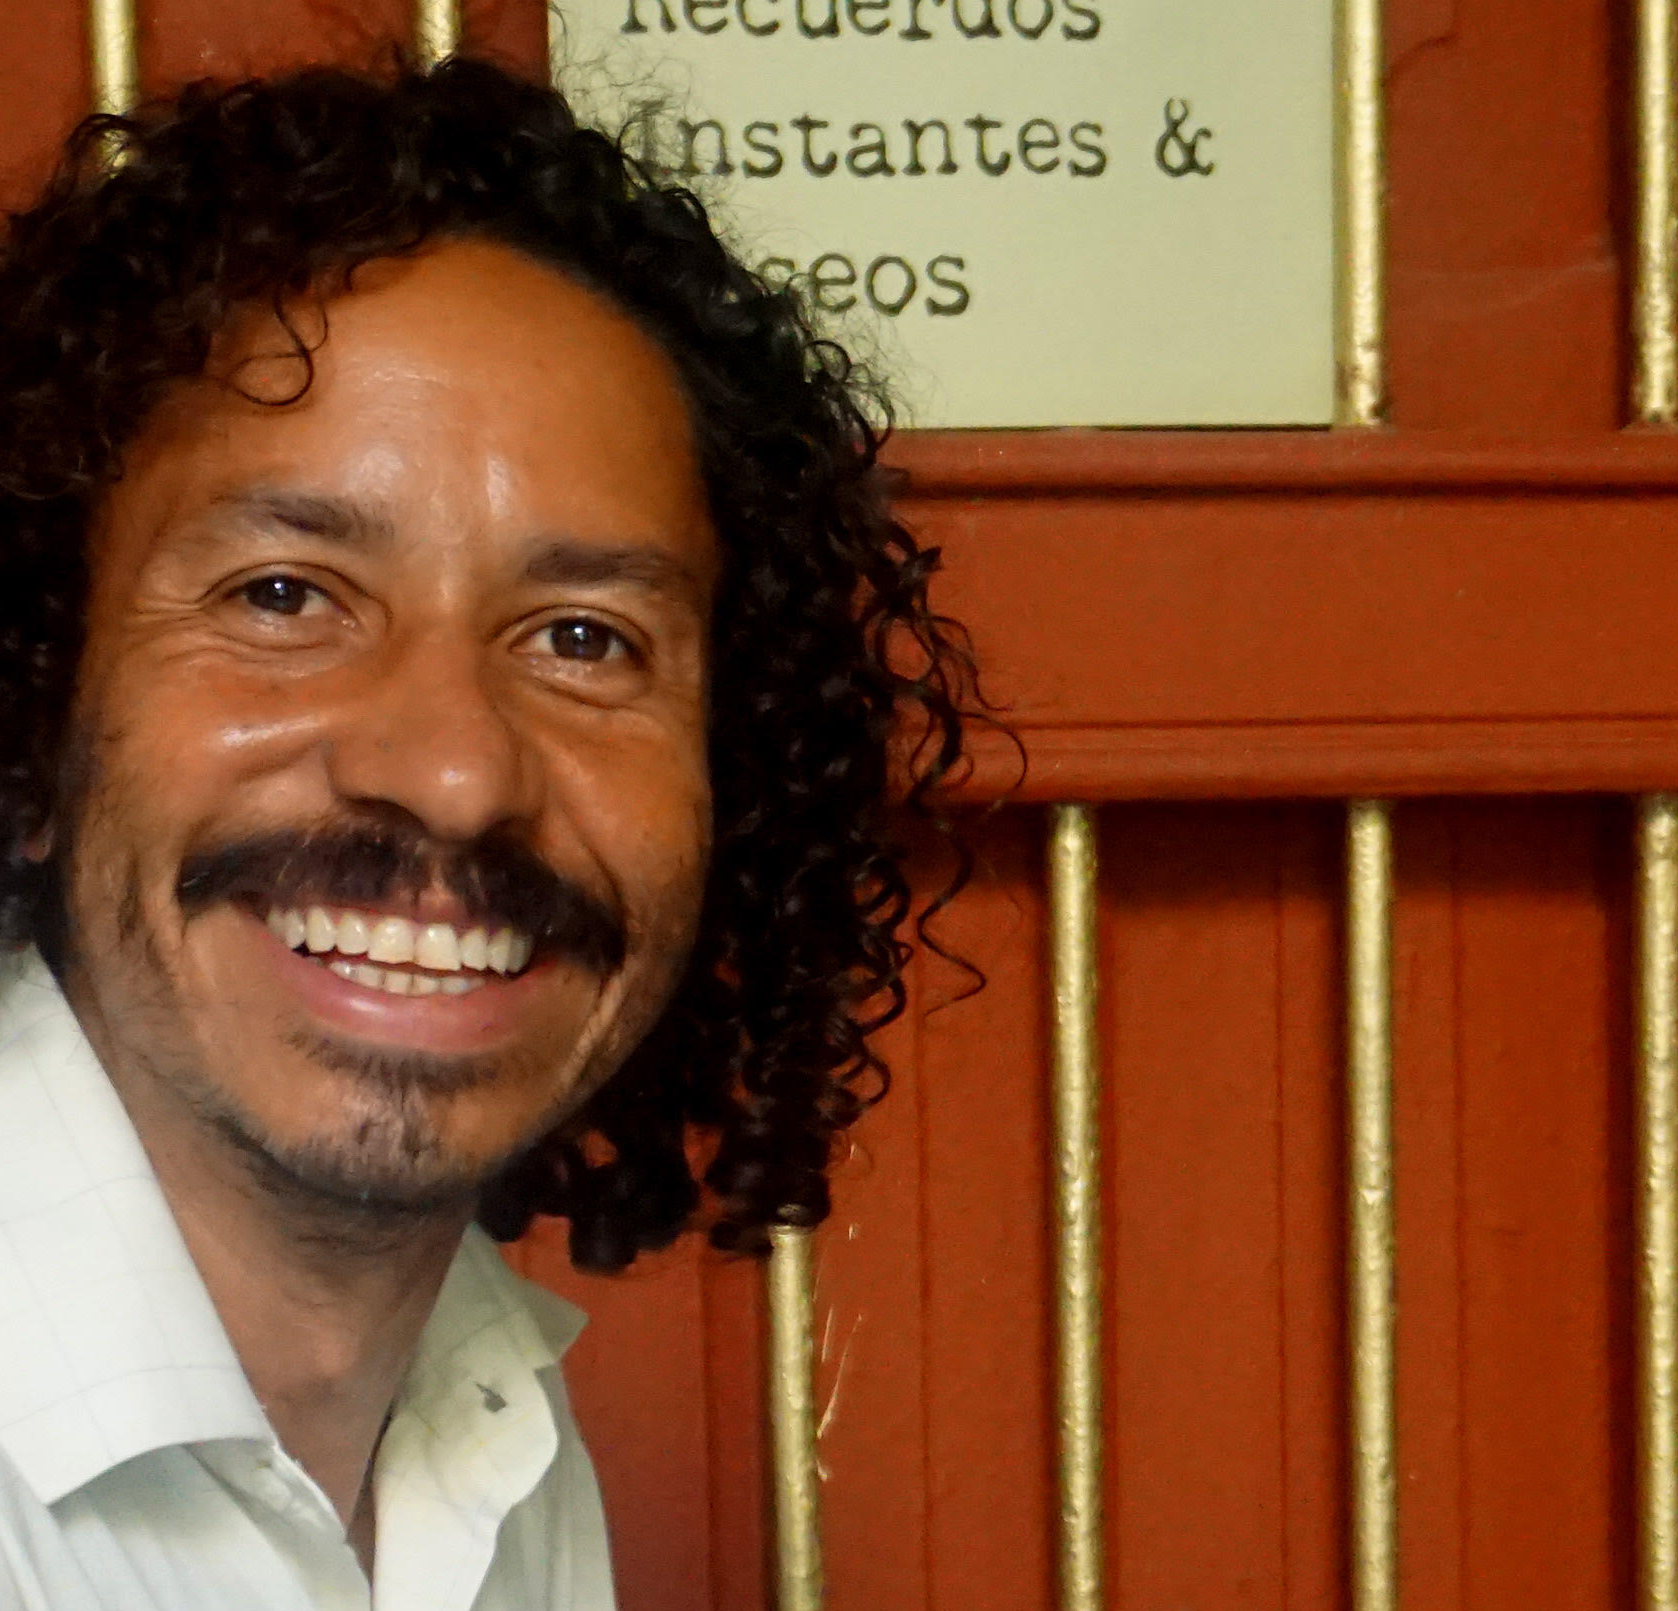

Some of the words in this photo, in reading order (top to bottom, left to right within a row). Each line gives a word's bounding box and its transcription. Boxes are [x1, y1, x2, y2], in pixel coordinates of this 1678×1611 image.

[626, 97, 1107, 178] Instantes
[1154, 97, 1215, 178] &
[755, 253, 971, 317] seos
